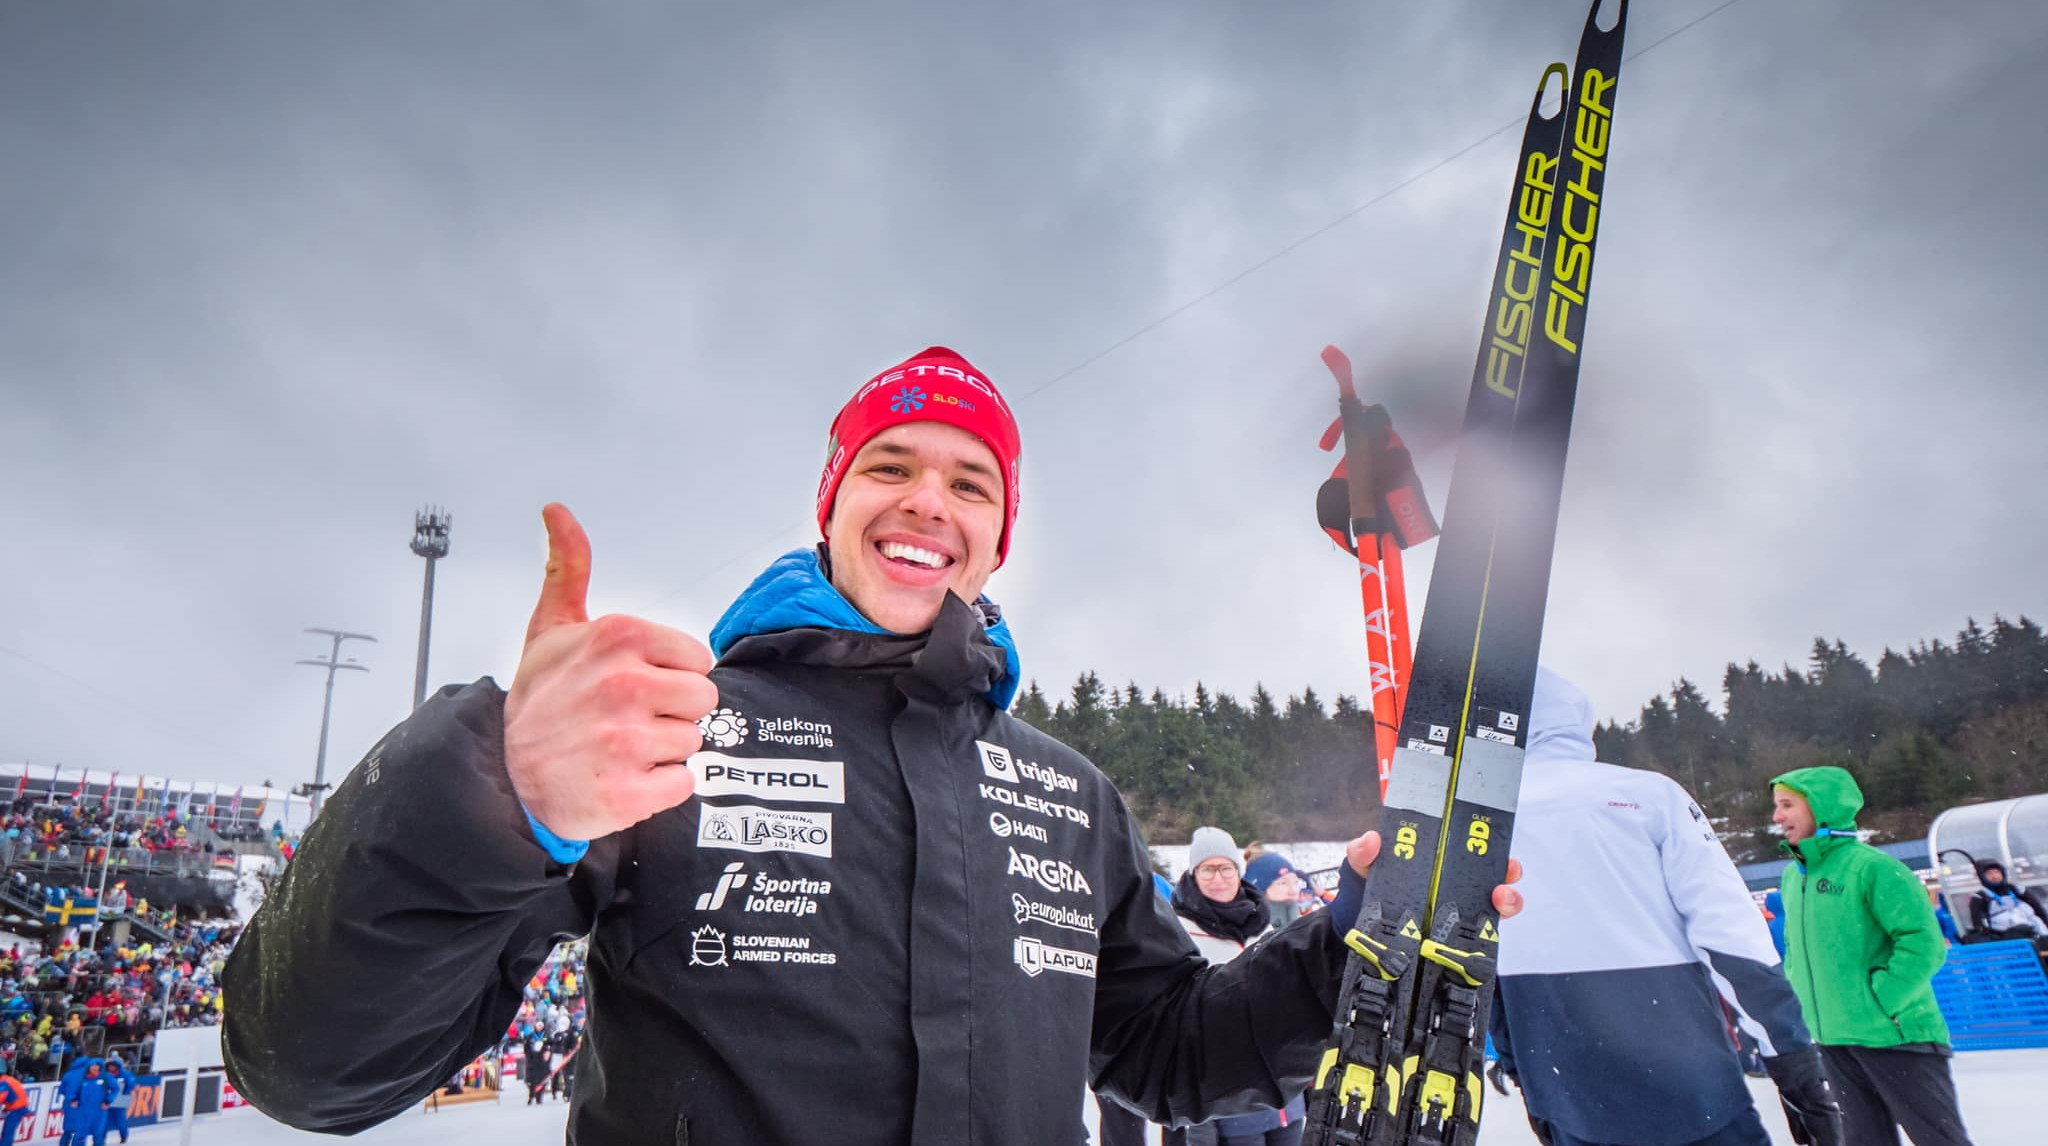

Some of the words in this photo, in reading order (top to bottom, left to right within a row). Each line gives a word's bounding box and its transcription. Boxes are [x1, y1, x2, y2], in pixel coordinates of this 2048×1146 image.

[1544, 67, 1617, 355] FISCHER
[1485, 150, 1559, 400] FISCHER
[856, 364, 1010, 418] PETROL
[755, 717, 833, 735] Telekom
[757, 728, 834, 748] Slovenije
[705, 764, 829, 789] PETROL
[1016, 758, 1078, 792] triglav
[978, 783, 1091, 829] KOLEKTOR
[740, 816, 828, 846] LAŠKO
[1012, 820, 1048, 844] HALTI
[1394, 826, 1417, 860] 3D
[1466, 820, 1490, 856] 3D
[752, 871, 832, 896] Športna
[744, 896, 818, 917] loterija
[1031, 902, 1095, 930] europlakat
[732, 935, 810, 949] SLOVENIAN
[732, 950, 782, 963] ARMED
[784, 951, 837, 965] FORCES
[1043, 952, 1094, 971] LAPUA
